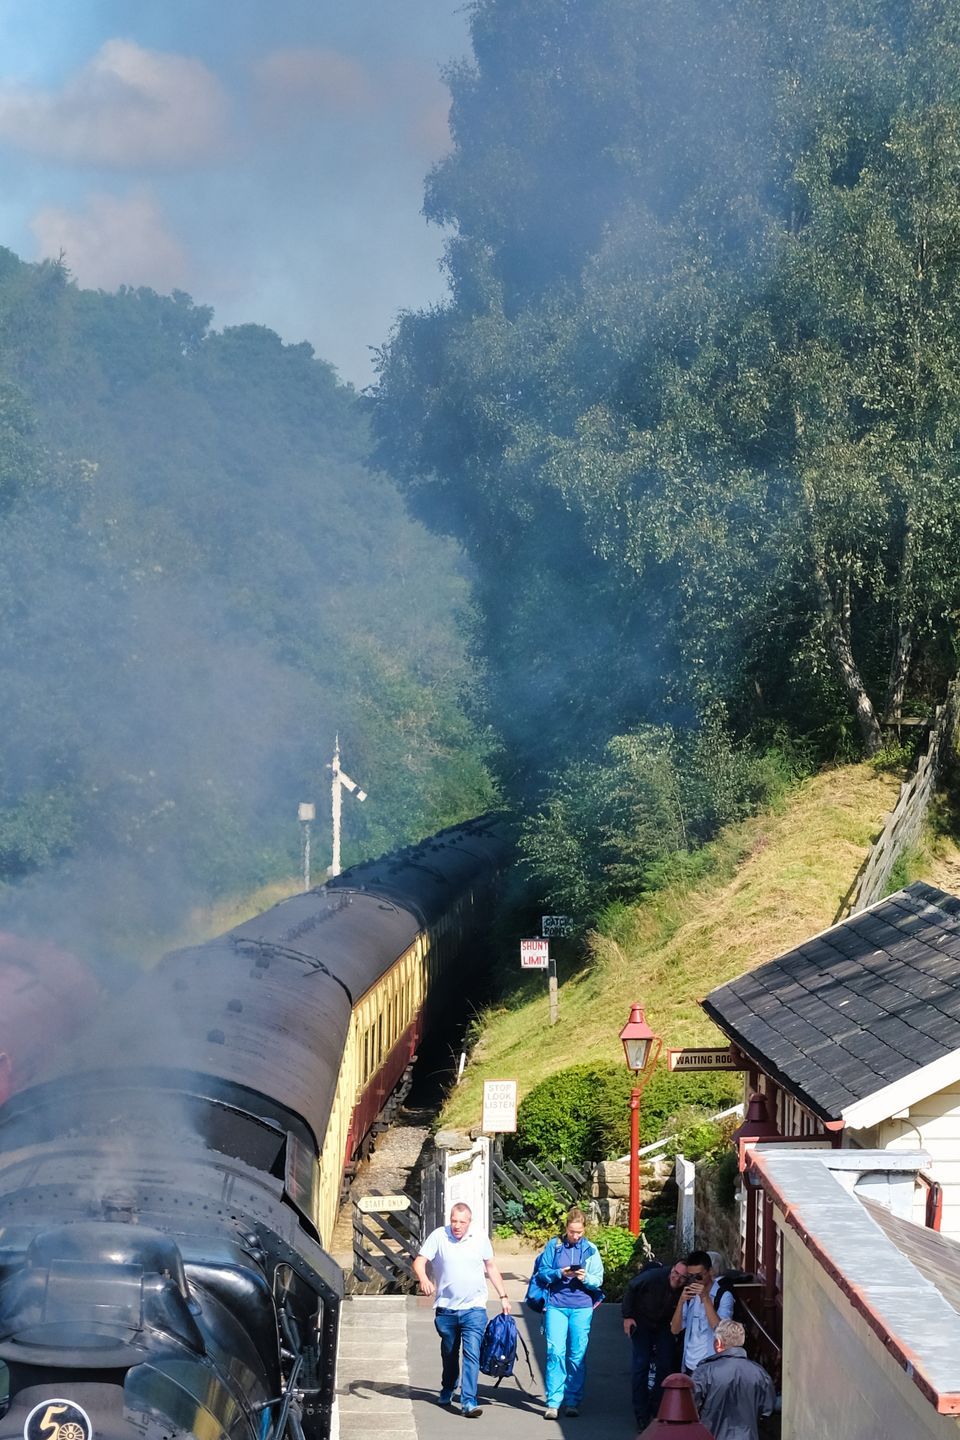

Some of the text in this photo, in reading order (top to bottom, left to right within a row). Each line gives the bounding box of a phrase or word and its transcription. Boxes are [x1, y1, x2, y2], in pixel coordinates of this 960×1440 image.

[522, 940, 548, 951] SHUNT
[523, 956, 547, 965] LIMIT
[676, 1055, 732, 1065] WAITING ROO
[488, 1084, 512, 1092] STOP
[484, 1101, 515, 1109] LISTEN
[364, 1199, 404, 1209] STAFF ONLY
